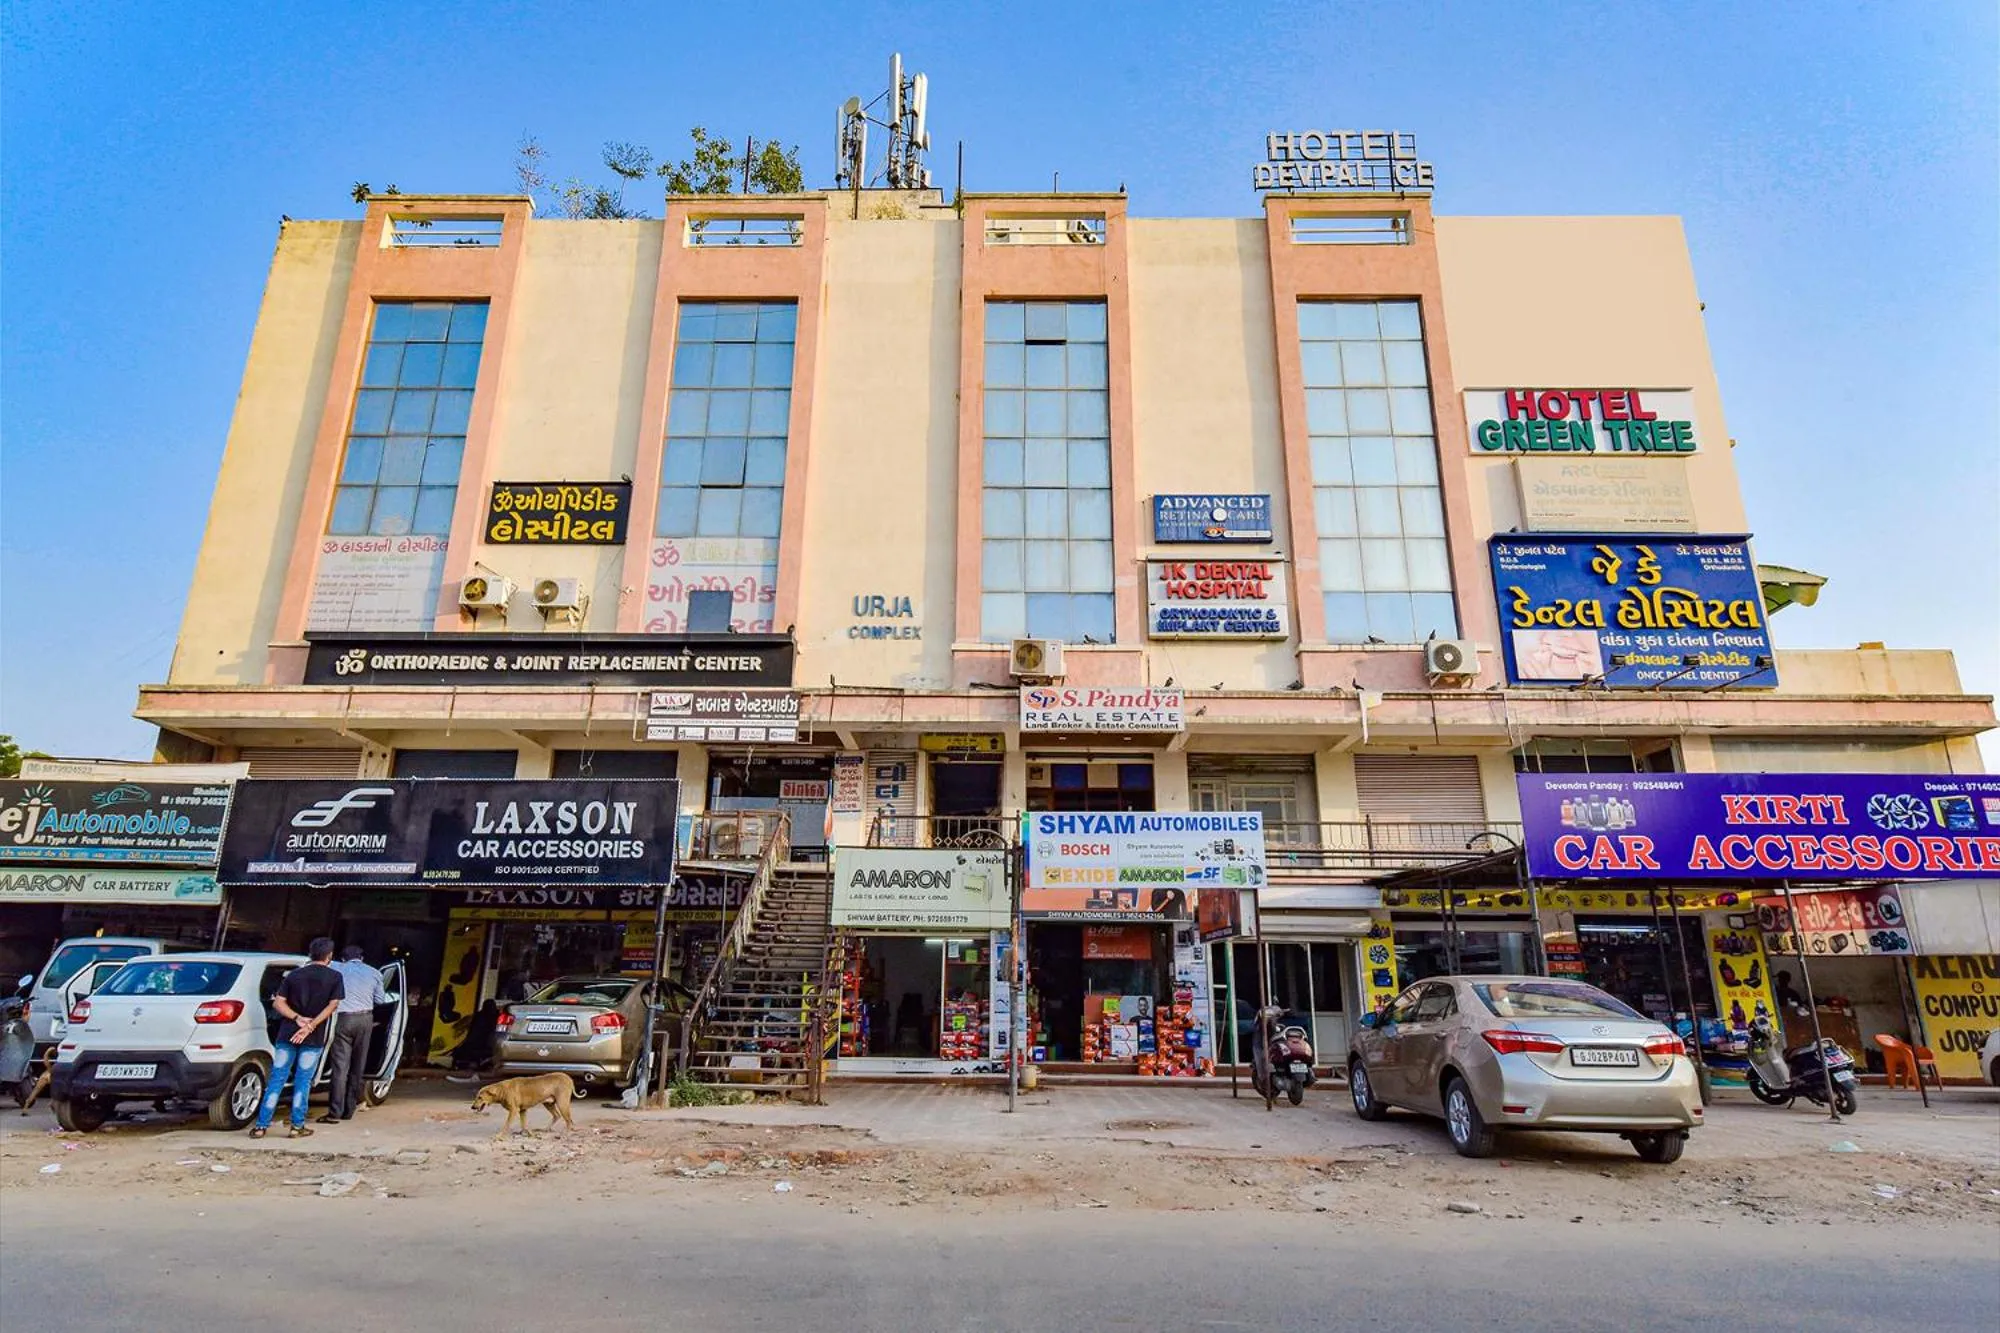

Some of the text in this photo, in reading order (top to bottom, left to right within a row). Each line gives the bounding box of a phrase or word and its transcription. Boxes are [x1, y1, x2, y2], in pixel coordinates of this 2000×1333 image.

[1268, 129, 1416, 161] HOTEL
[1505, 388, 1657, 421] HOTEL
[1478, 419, 1697, 452] GREEN TREE
[1160, 498, 1264, 508] ADVANCED
[1159, 509, 1264, 520] RETINA CARE
[490, 511, 616, 541] હોસ્પીટલ
[1160, 561, 1273, 580] JK DENTAL
[1592, 545, 1663, 585] જે કે
[1166, 581, 1268, 599] HOSPITAL
[854, 595, 914, 617] URJA
[1159, 608, 1262, 620] ORTHODONTIC
[1509, 586, 1761, 629] ડેન્ટલ હોસ્પિટલ
[848, 626, 922, 640] COMPLEX
[1157, 620, 1280, 632] IMPLANT CENTRE
[370, 655, 762, 671] ORTHOPAEDIC & JOINT REPLACEMENT CENTER
[1637, 670, 1665, 680] ONGC
[1700, 670, 1741, 680] DENTIST
[1025, 712, 1179, 722] REAL ESTATE
[1545, 782, 1588, 790] Devendra
[1590, 782, 1623, 792] Panday
[1924, 782, 1959, 792] Deepak
[471, 801, 638, 834] LAXSON
[1720, 794, 1850, 825] KIRTI
[37, 806, 190, 836] Automobile
[1039, 815, 1259, 834] SHYAM AUTOMOBILES
[47, 835, 67, 846] Type
[137, 837, 168, 846] Service
[457, 840, 644, 858] CAR ACCESSORIES
[1061, 843, 1110, 856] BOSCH
[1554, 835, 1661, 870] CAR
[495, 866, 511, 874] ISO
[554, 866, 600, 874] CERTIFIED
[1060, 867, 1116, 883] EXIDE
[1118, 867, 1185, 883] AMARON
[1203, 866, 1220, 880] SF
[93, 881, 115, 890] CAR
[119, 881, 171, 891] BATTERY
[850, 869, 951, 889] AMARON
[1924, 994, 2000, 1018] COMPU
